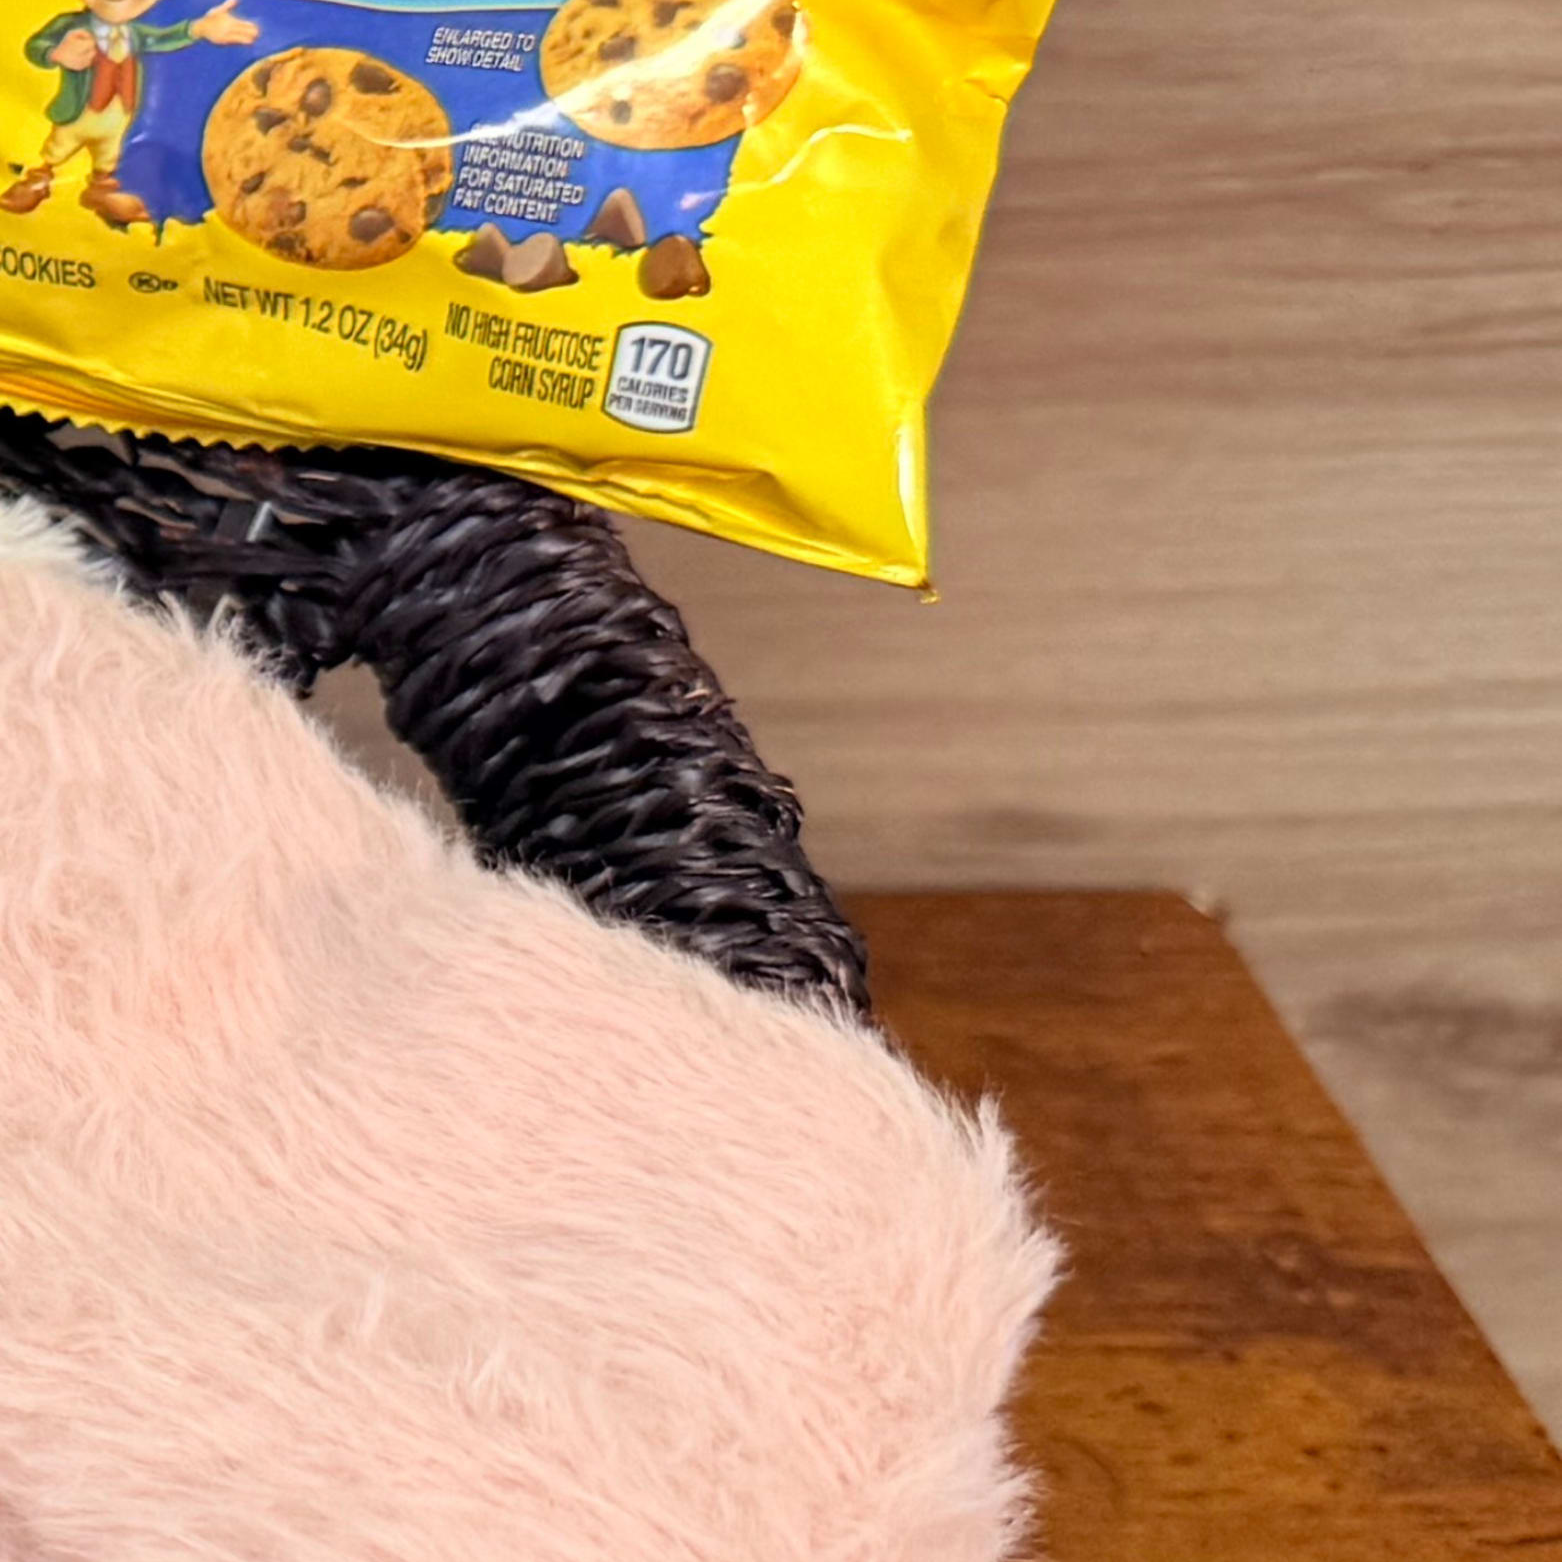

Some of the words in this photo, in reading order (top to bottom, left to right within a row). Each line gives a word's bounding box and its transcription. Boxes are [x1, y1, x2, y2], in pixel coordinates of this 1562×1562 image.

[432, 26, 514, 50] ENLARGED
[516, 34, 536, 52] TO
[425, 46, 472, 67] SHOW
[463, 144, 569, 178] INFORMATION
[453, 187, 482, 208] FAT
[458, 167, 492, 188] FOR
[493, 172, 584, 205] SATURATED
[203, 275, 253, 311] NET
[254, 289, 294, 322] WT
[300, 295, 336, 335] 1.2
[337, 303, 373, 347] OZ
[372, 314, 429, 373] (34g)
[444, 300, 471, 342] NO
[472, 312, 511, 354] HIGH
[511, 321, 605, 373] FRUCTOSE
[630, 335, 694, 382] 170
[488, 356, 535, 398] CORN
[536, 368, 596, 411] SYRUP
[617, 375, 689, 405] CALORIES
[608, 392, 633, 411] PER
